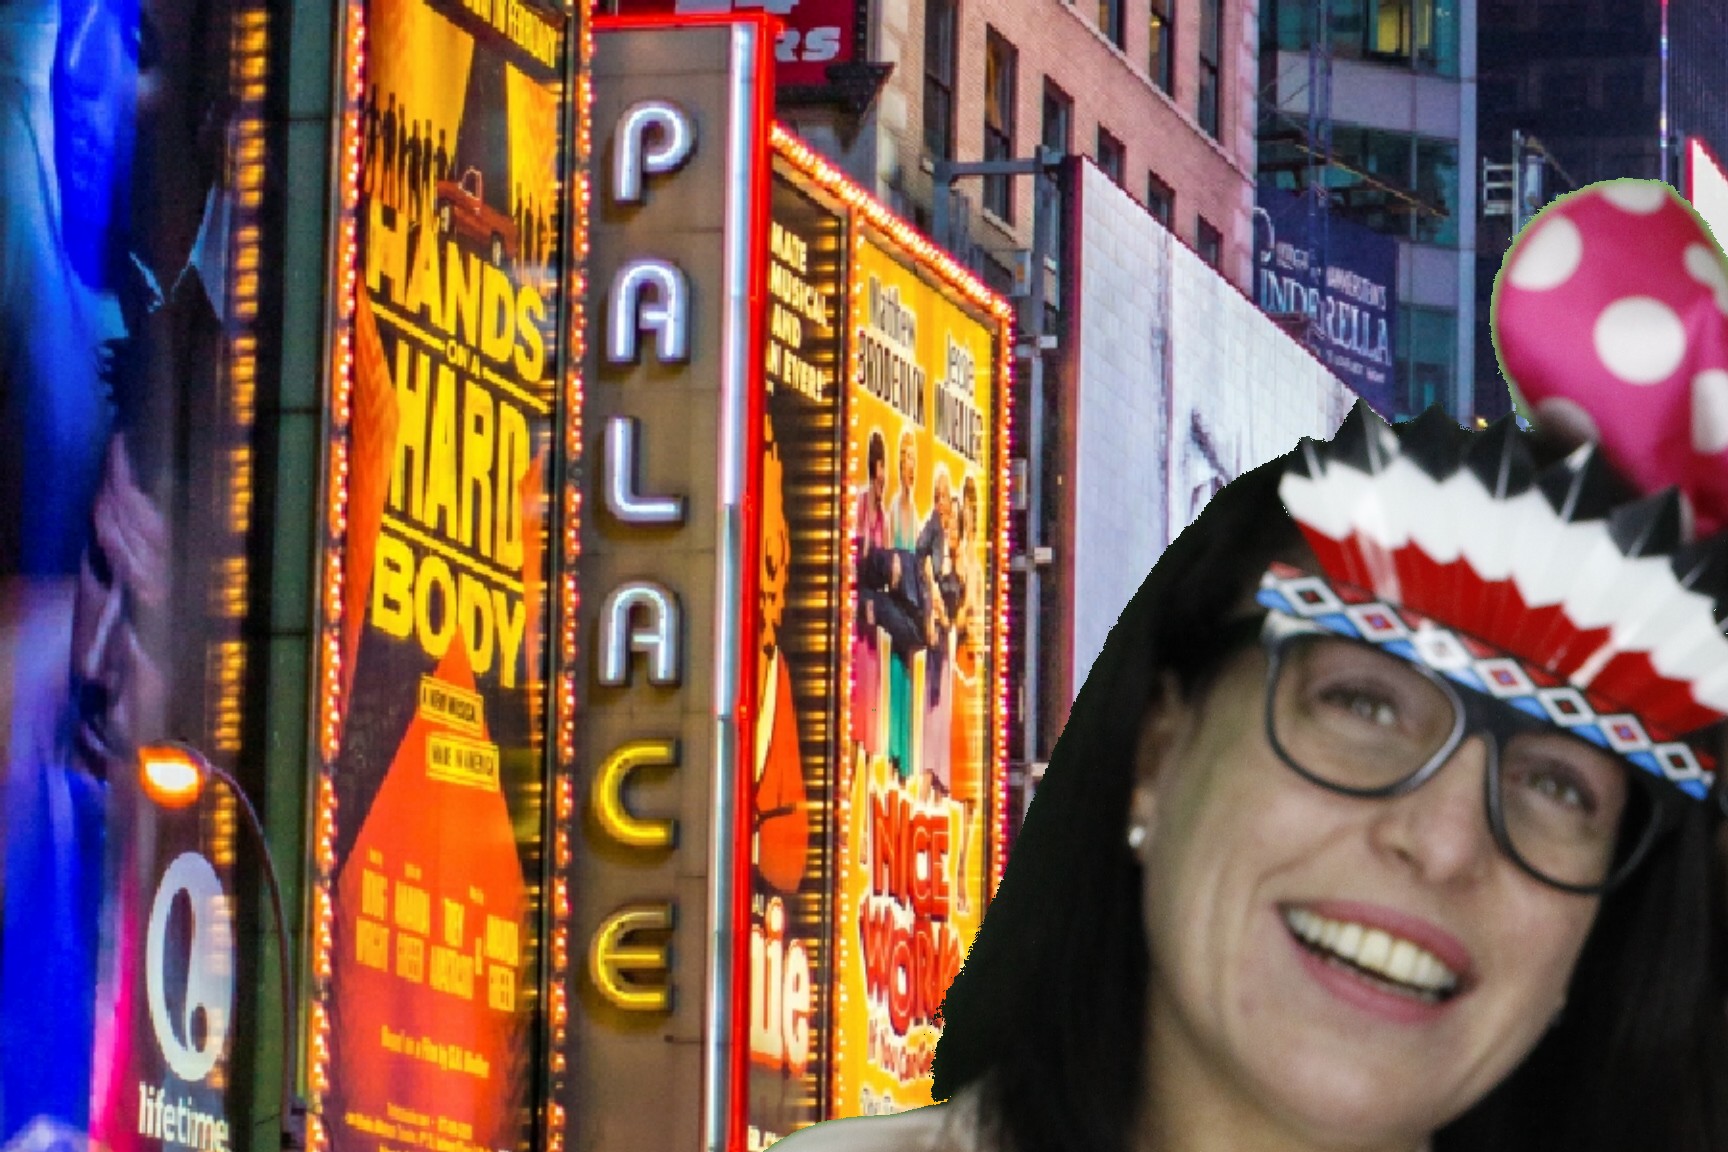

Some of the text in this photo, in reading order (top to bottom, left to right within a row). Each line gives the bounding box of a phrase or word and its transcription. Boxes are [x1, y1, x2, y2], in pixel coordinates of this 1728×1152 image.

[366, 198, 545, 383] HANDS
[389, 337, 531, 572] HARD
[371, 529, 526, 688] BODY
[589, 101, 697, 1012] PALACE
[871, 788, 950, 923] NICE
